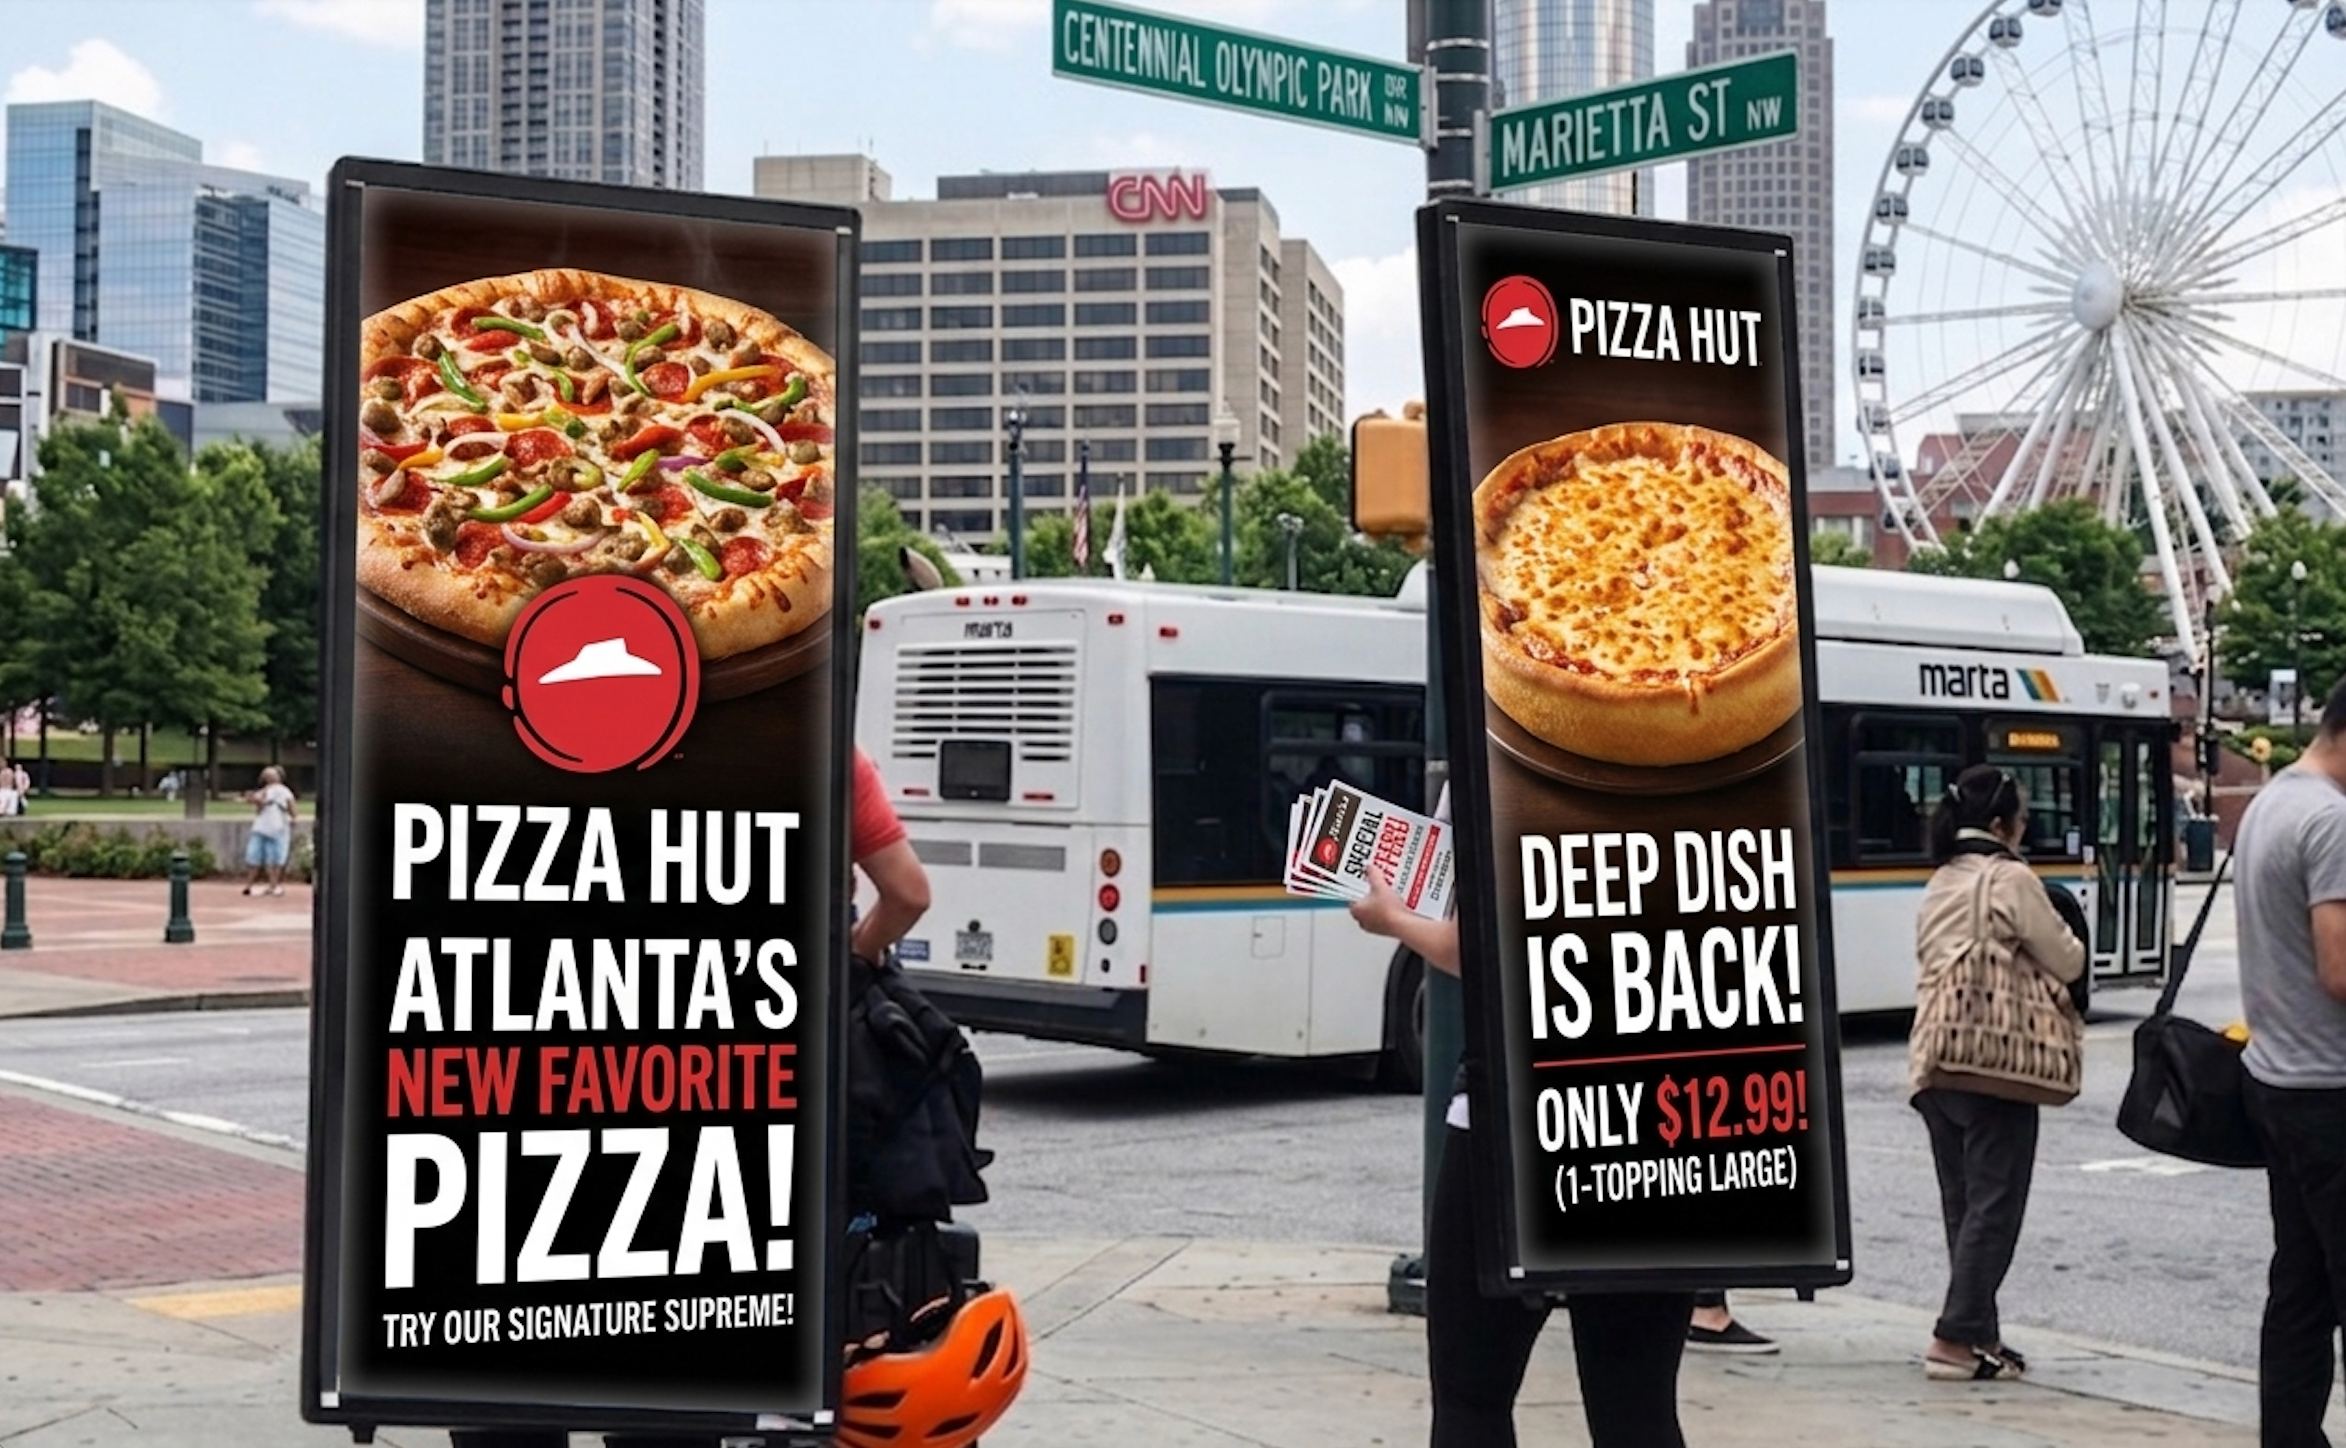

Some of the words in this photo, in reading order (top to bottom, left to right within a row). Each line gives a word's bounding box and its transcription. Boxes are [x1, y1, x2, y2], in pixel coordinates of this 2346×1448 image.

[1063, 10, 1206, 88] CENTENNIAL
[1215, 40, 1309, 109] OLYMPIC
[1317, 61, 1373, 121] PARK
[1502, 91, 1671, 178] MARIETTA
[1687, 77, 1732, 142] ST
[1746, 96, 1783, 132] NW
[1107, 173, 1207, 223] CNN
[1570, 297, 1681, 361] PIZZA
[1689, 307, 1762, 366] HUT
[1919, 663, 2010, 700] marta
[392, 802, 625, 906] PIZZA
[650, 808, 800, 906] HUT
[1520, 832, 1660, 920] DEEP
[1673, 828, 1797, 913] DISH
[1528, 932, 1593, 1040] IS
[1611, 924, 1804, 1035] BACK!
[387, 1047, 521, 1117] NEW
[539, 1045, 797, 1115] FAVORITE
[1537, 1082, 1644, 1153] ONLY
[1656, 1070, 1808, 1149] $12.99!
[384, 1124, 796, 1290] PIZZA!
[1555, 1153, 1702, 1213] (1-TOPPING
[1709, 1144, 1798, 1192] LARGE)
[382, 1311, 436, 1348] TRY
[444, 1308, 501, 1345] OUR
[507, 1300, 657, 1342] SIGNATURE
[663, 1292, 795, 1332] SUPREME!
